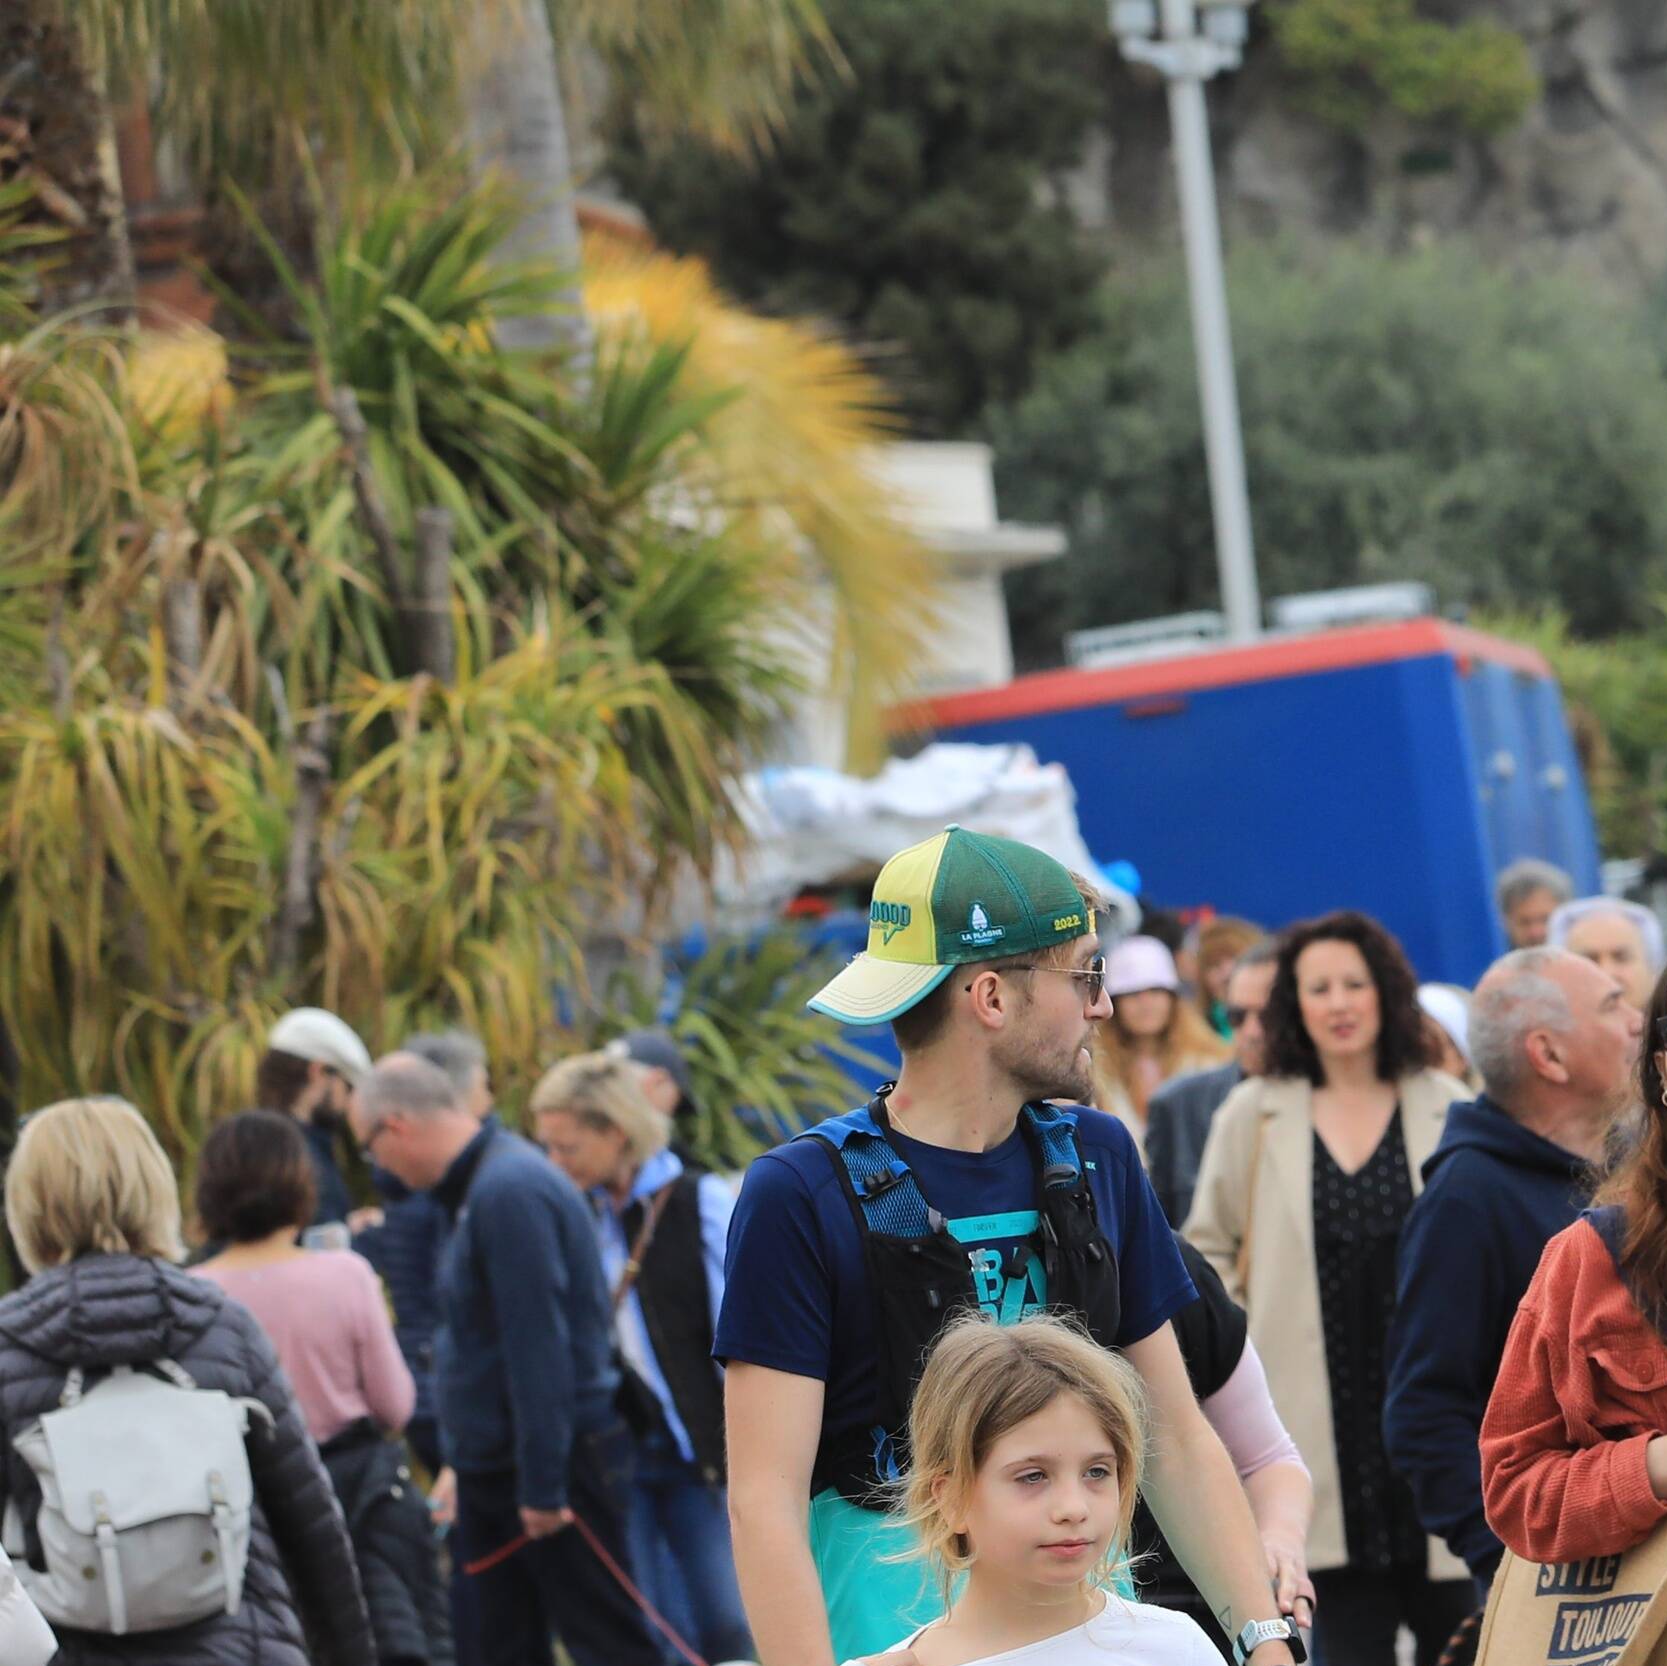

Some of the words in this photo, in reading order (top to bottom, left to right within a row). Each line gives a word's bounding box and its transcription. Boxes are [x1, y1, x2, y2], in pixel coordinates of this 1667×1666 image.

[1054, 914, 1081, 931] 2022
[961, 933, 973, 942] LA
[973, 928, 1003, 940] PLAGNE
[1540, 1556, 1618, 1589] STYLE
